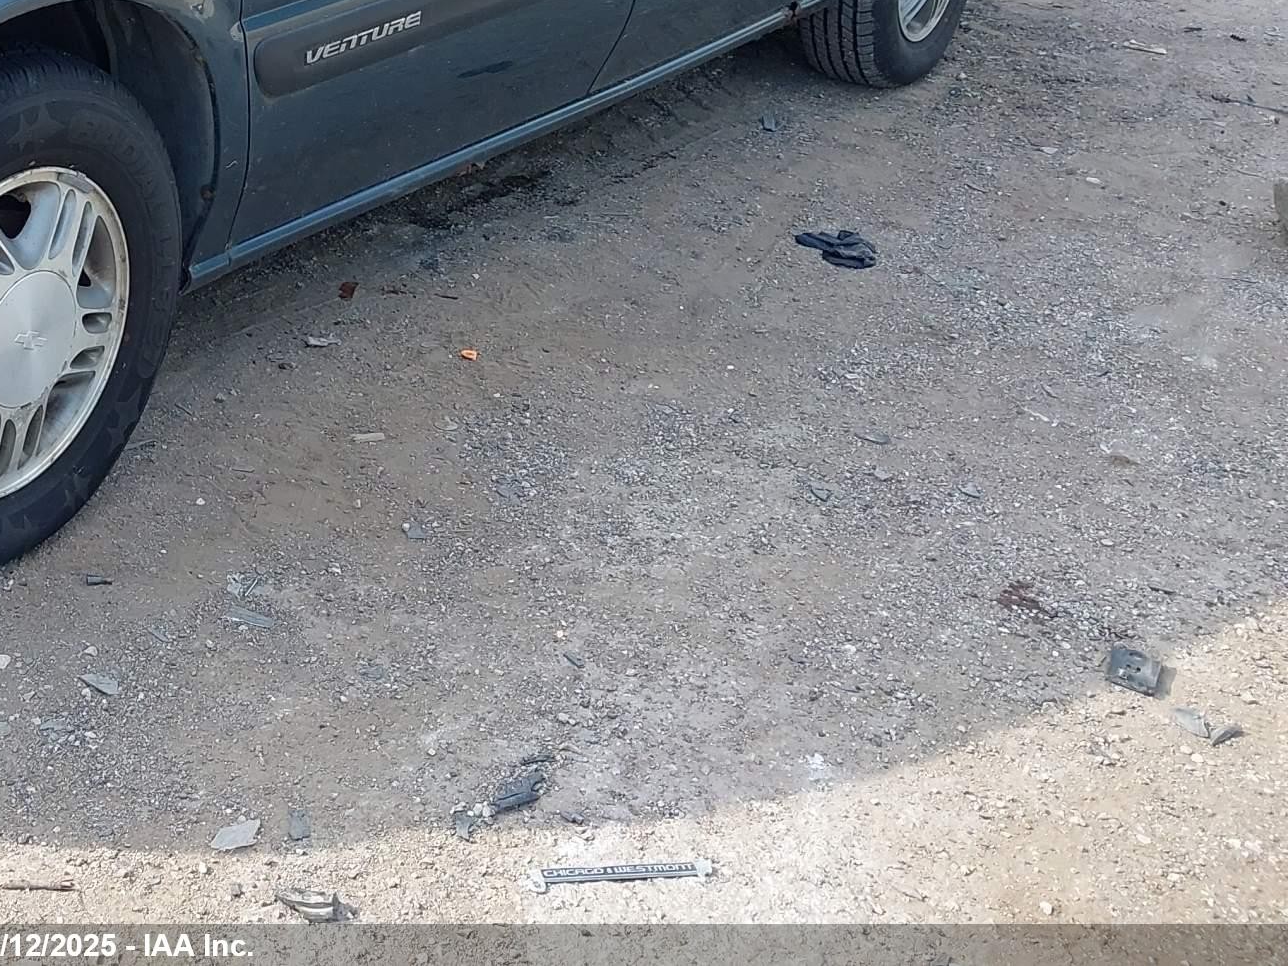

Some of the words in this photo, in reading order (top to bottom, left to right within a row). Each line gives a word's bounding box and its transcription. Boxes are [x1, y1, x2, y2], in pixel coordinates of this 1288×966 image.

[305, 10, 422, 64] VENTURE
[543, 867, 604, 878] CHICAGO
[612, 863, 694, 874] WESTMONT
